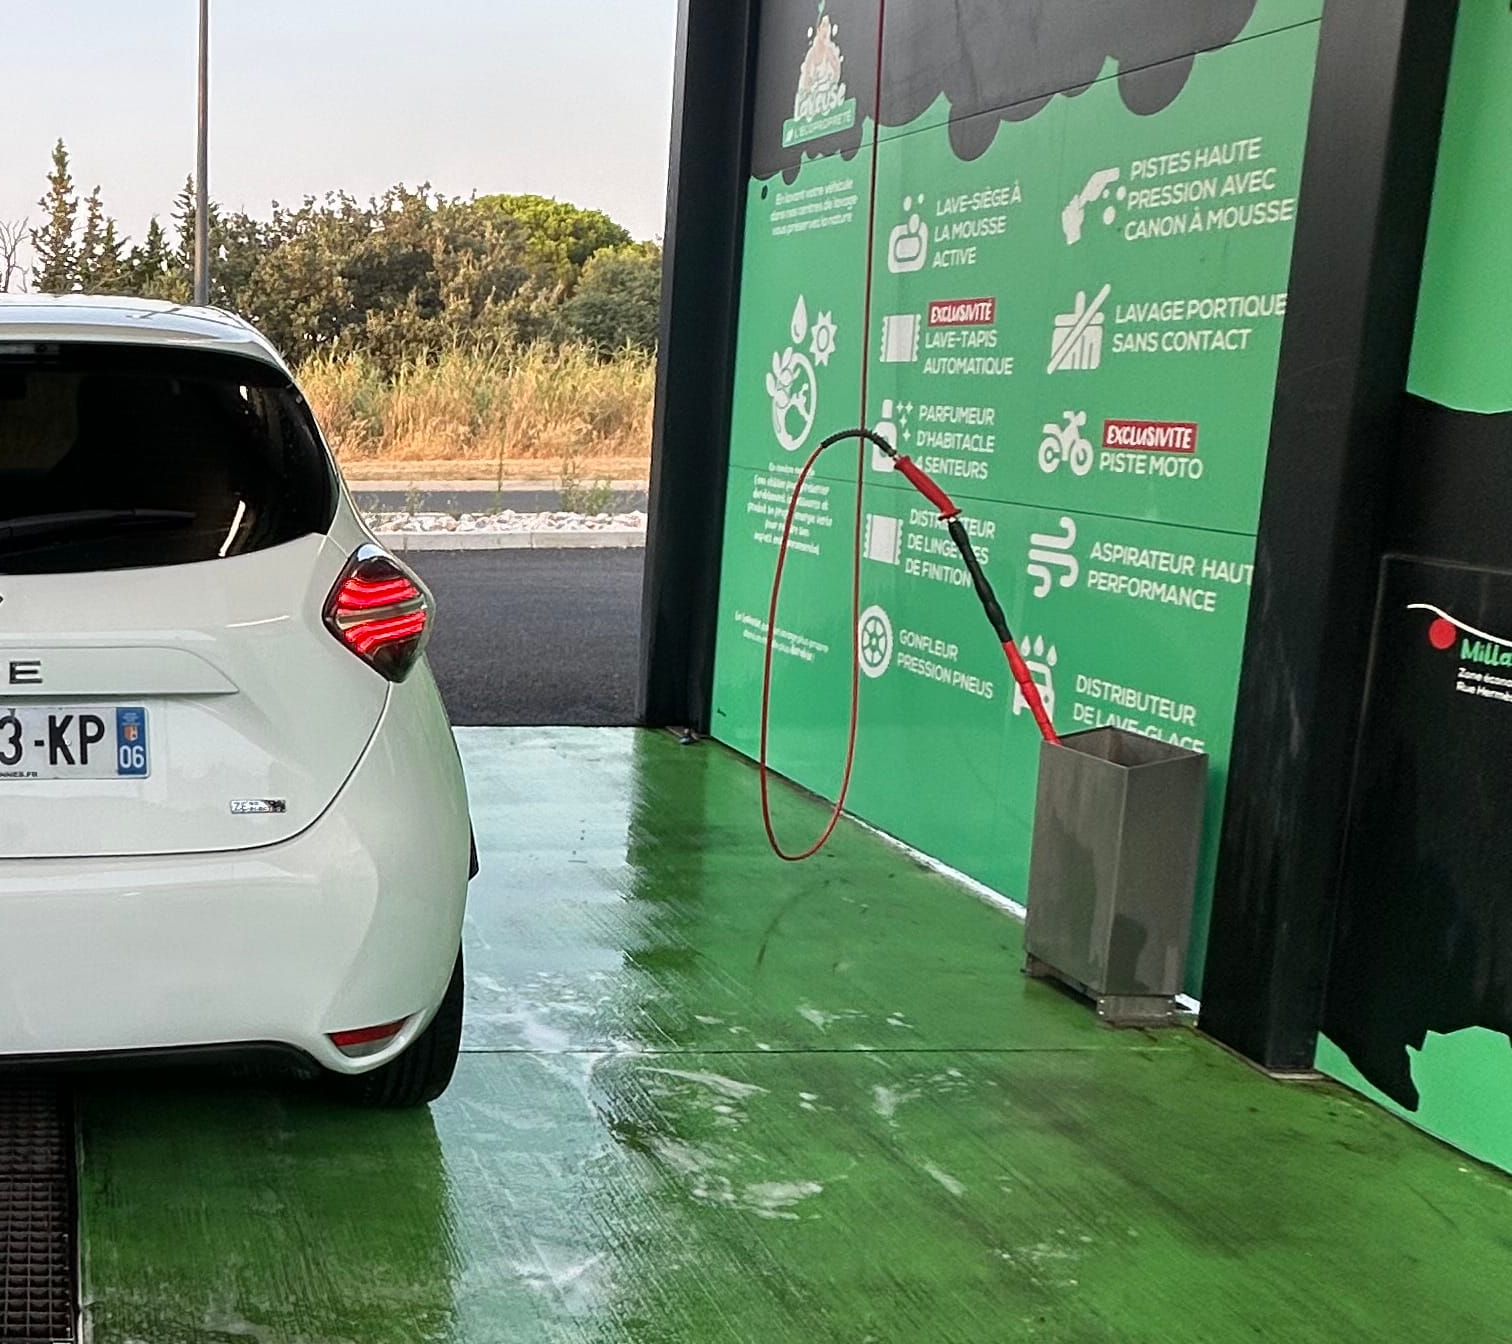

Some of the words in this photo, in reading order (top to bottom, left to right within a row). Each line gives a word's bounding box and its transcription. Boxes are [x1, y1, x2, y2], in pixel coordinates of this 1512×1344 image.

[1130, 151, 1191, 181] PISTES
[1194, 137, 1263, 169] HAUTE
[936, 186, 1010, 217] LAVE-SIÈGE
[1011, 180, 1021, 204] À
[1127, 178, 1217, 211] PRESSION
[1220, 168, 1277, 197] AVEC
[934, 226, 951, 243] LA
[952, 216, 1007, 240] MOUSSE
[1124, 215, 1186, 241] CANON
[1188, 207, 1204, 233] À
[1206, 198, 1297, 231] MOUSSE
[932, 247, 976, 268] ACTIVE
[1115, 300, 1185, 324] LAVAGE
[1187, 293, 1287, 320] PORTIQUE
[925, 330, 998, 349] LAVE-TAPIS
[1112, 332, 1158, 353] SANS
[1161, 328, 1252, 352] CONTACT
[923, 357, 1014, 375] AUTOMATIQUE
[919, 405, 995, 425] PARFUMEUR
[916, 430, 995, 453] D'HABITACLE
[924, 456, 988, 480] SENTEURS
[1099, 452, 1147, 474] PISTE
[1149, 455, 1203, 479] MOTO
[909, 508, 996, 539] DISTRTEUR
[907, 533, 923, 551] DE
[924, 536, 989, 565] LINGEES
[1090, 542, 1195, 576] ASPIRATEUR
[1201, 558, 1255, 586] HAUT
[905, 557, 921, 575] DE
[922, 561, 972, 587] FINITION
[1088, 570, 1217, 612] PERFORMANCE
[899, 628, 958, 662] GONFLEUR
[1460, 638, 1512, 667] Milla
[897, 652, 952, 685] PRESSION
[953, 670, 994, 700] PNEUS
[1455, 681, 1477, 695] Rue
[1457, 667, 1483, 682] Zone
[1075, 674, 1196, 727] DISTRIBUTEUR
[1073, 703, 1095, 726] DE
[1095, 709, 1206, 754] LAVE-GLACE
[119, 745, 145, 769] 06
